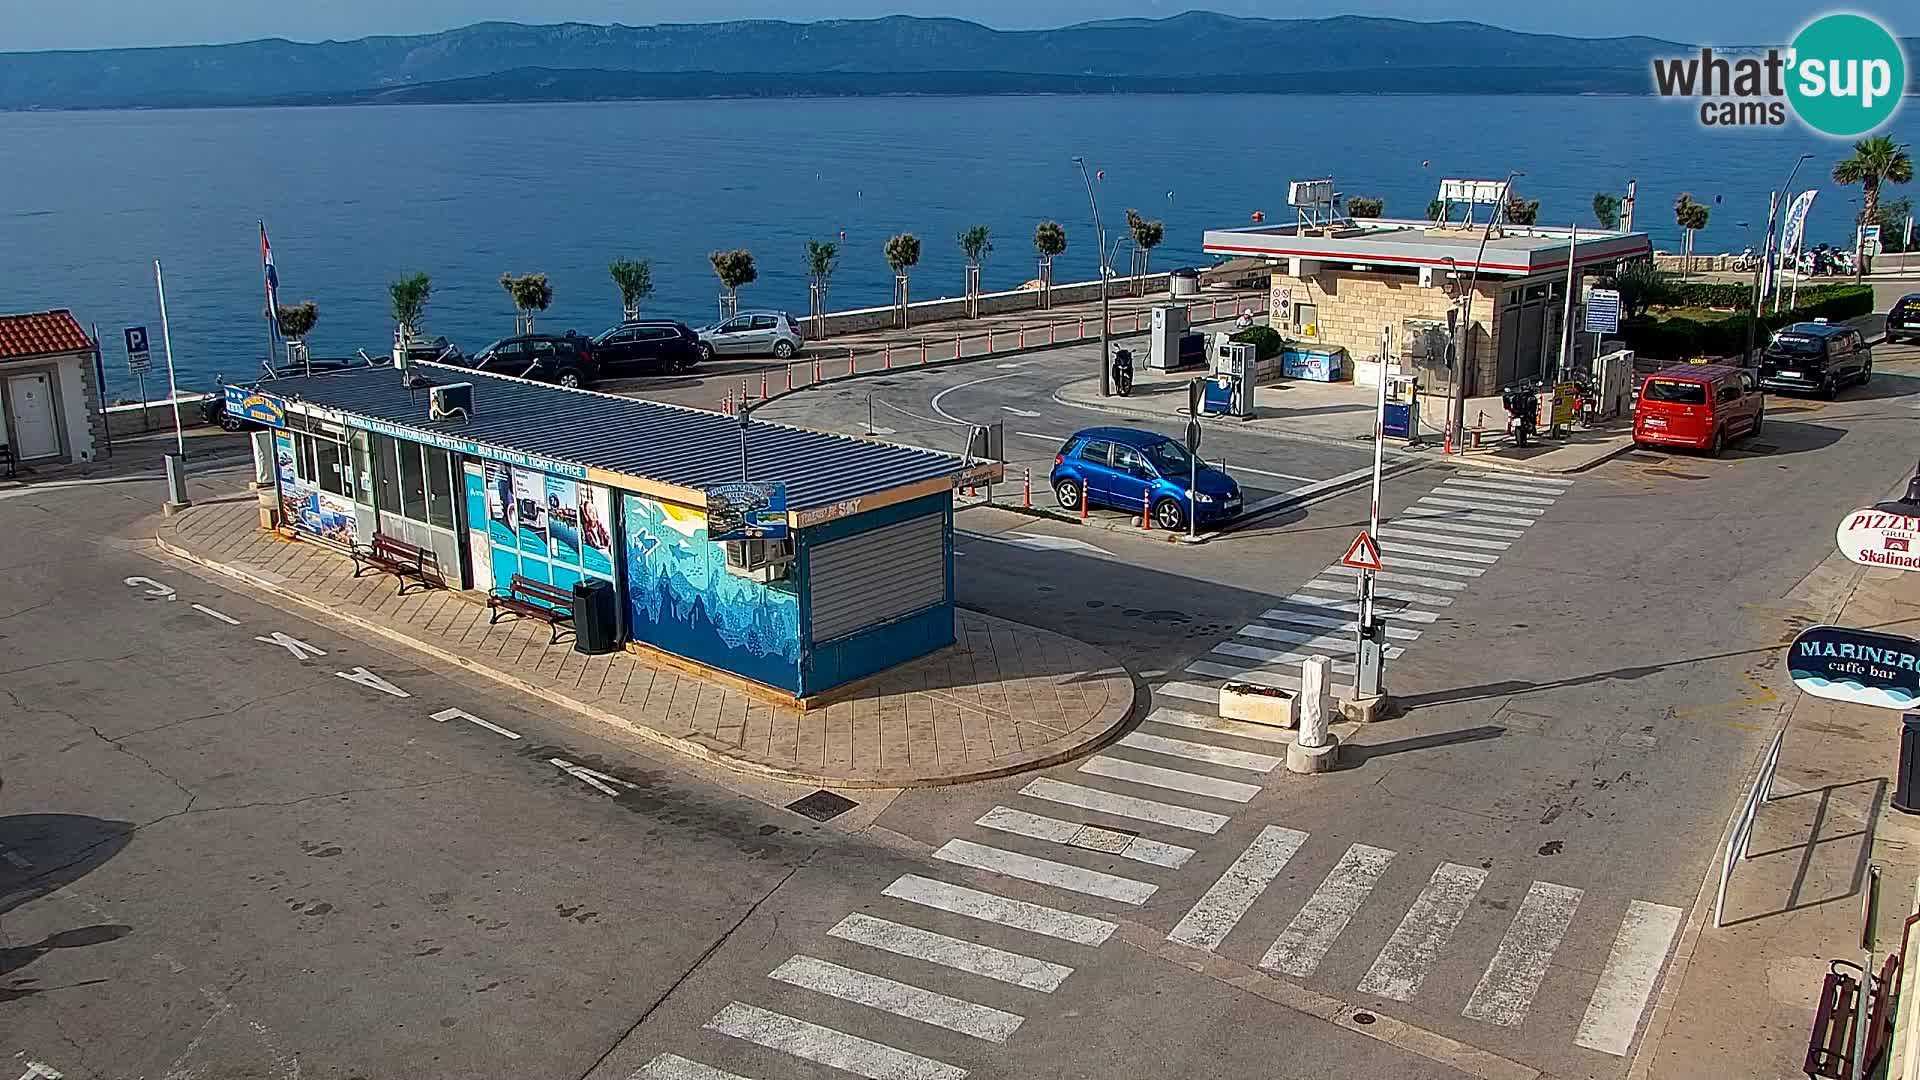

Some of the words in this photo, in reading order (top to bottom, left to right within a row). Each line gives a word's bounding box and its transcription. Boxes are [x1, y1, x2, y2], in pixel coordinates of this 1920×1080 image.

[396, 425, 435, 444] AUTOBUSNA
[435, 436, 467, 451] POSTAJA
[477, 446, 493, 459] BUS
[493, 448, 526, 465] STATION
[527, 456, 554, 471] TICKET
[555, 462, 583, 477] OFFICE
[1881, 529, 1917, 539] GRILL
[1828, 661, 1865, 675] caffe
[1869, 664, 1897, 680] bar
